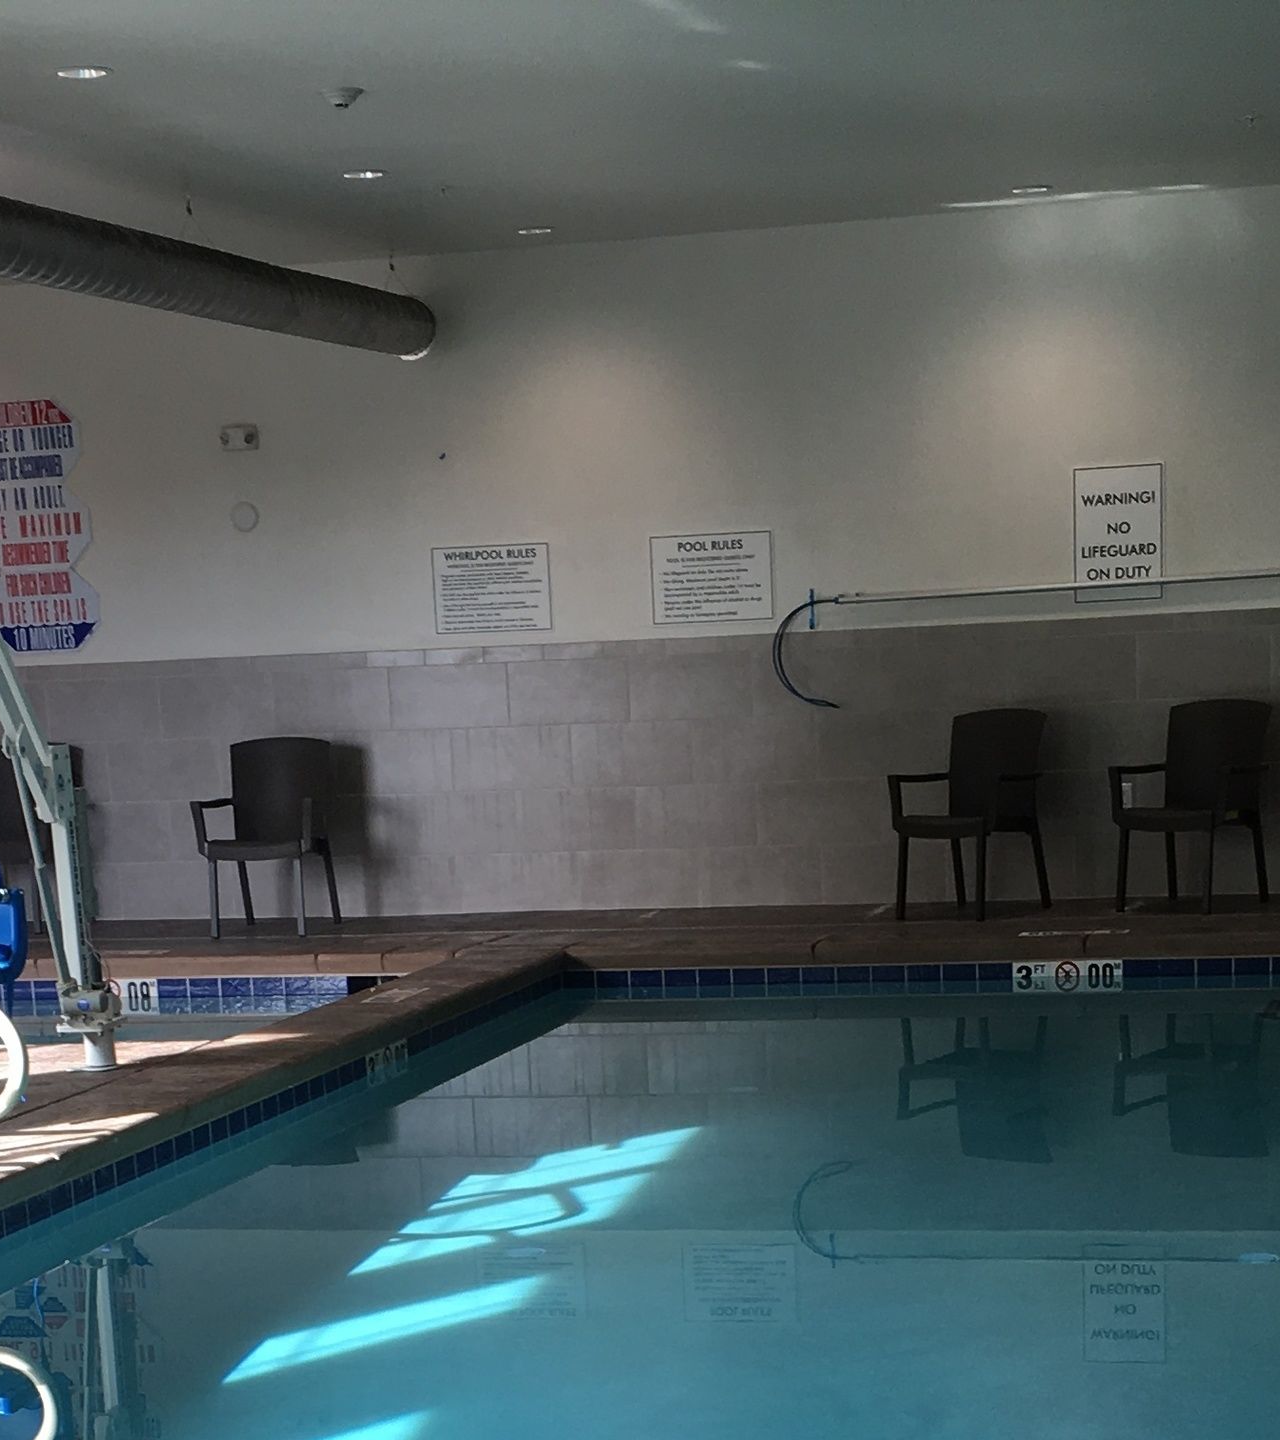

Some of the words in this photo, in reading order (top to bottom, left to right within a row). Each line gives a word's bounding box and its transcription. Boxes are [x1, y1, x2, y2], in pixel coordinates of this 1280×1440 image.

[34, 401, 47, 424] 12
[1081, 490, 1156, 506] WARNING!
[19, 512, 82, 537] MAXIMUM
[1107, 522, 1131, 534] NO
[677, 541, 708, 552] POOL
[711, 539, 744, 550] RULES
[1082, 543, 1157, 558] LIFEGUARD
[444, 550, 503, 561] WHIRLPOOL
[506, 548, 537, 558] RULES
[1087, 568, 1110, 581] ON
[1116, 565, 1152, 579] DUTY
[32, 600, 49, 623] THE
[54, 598, 73, 622] SPA
[76, 597, 87, 620] IS
[13, 627, 26, 651] 10
[29, 624, 75, 650] MINUTES
